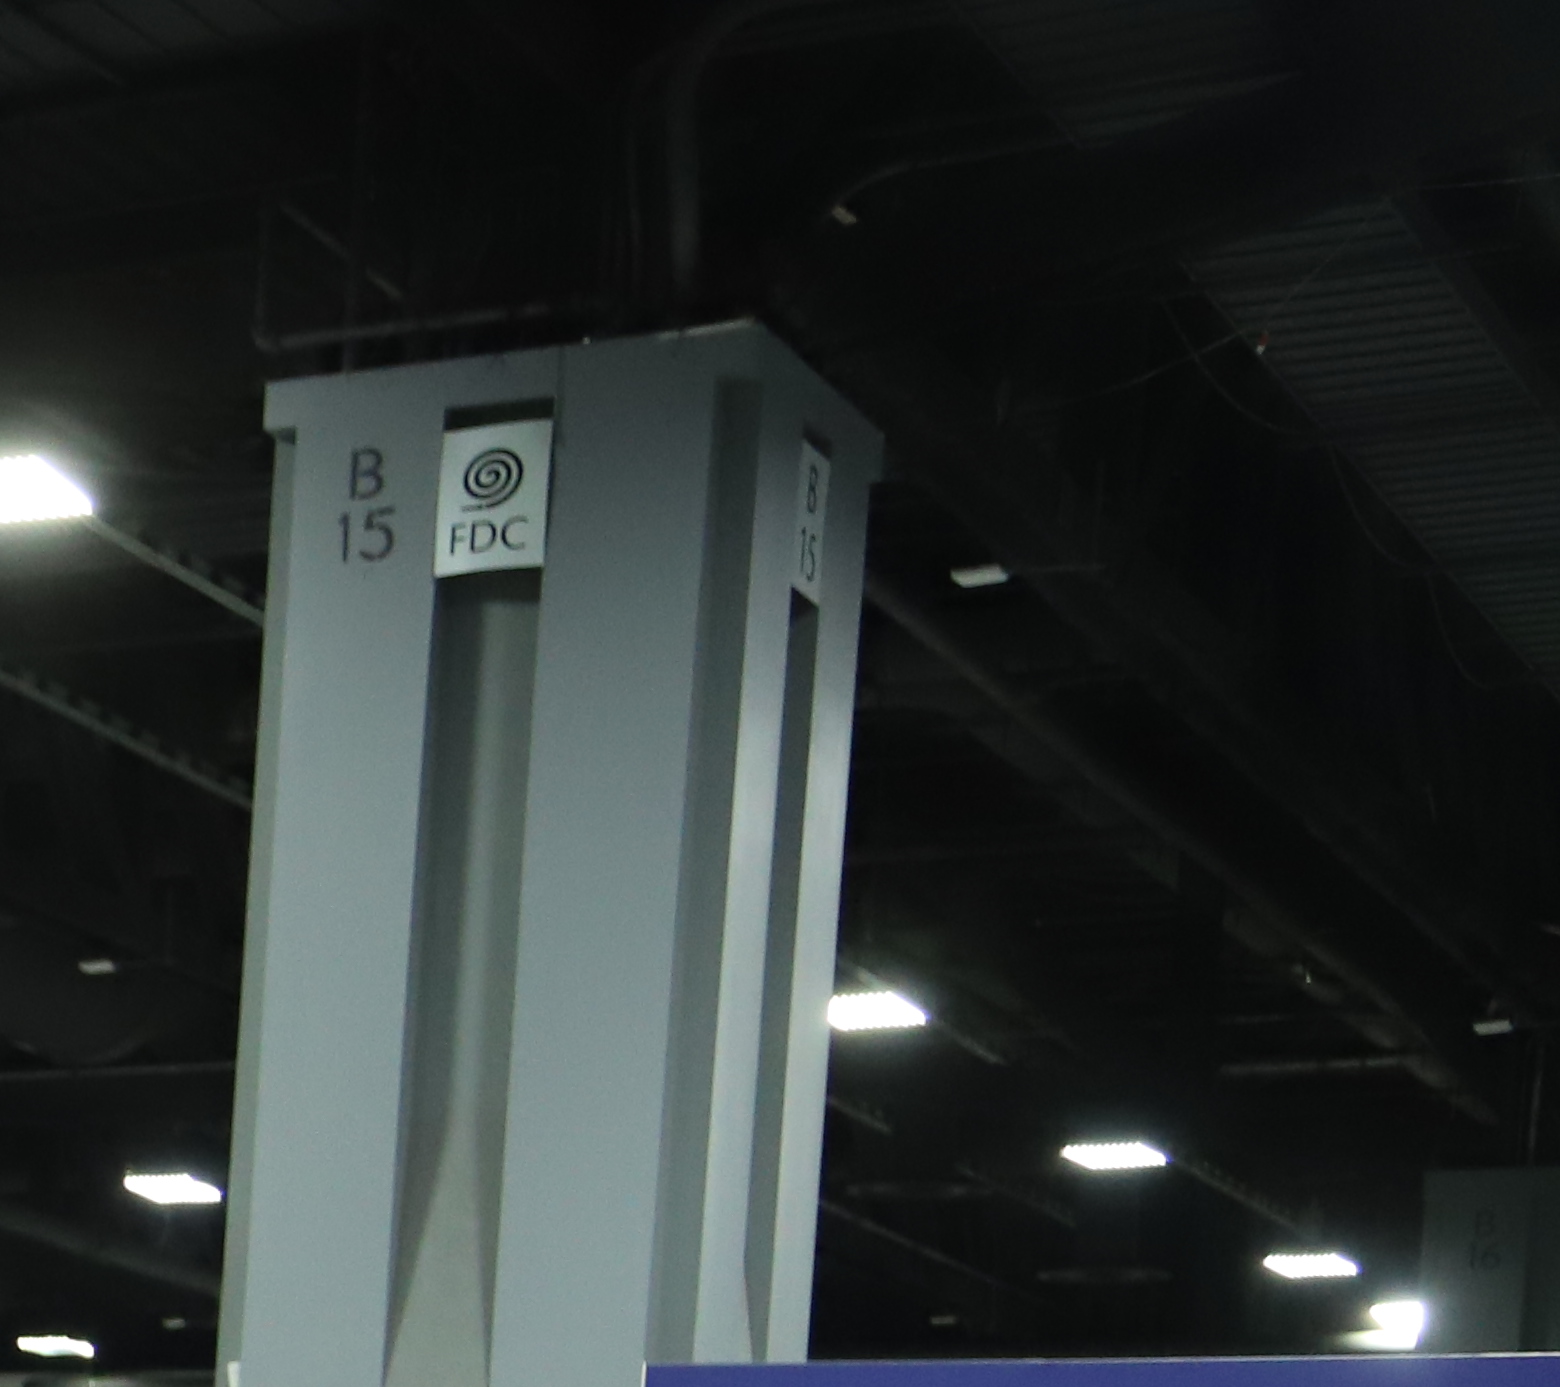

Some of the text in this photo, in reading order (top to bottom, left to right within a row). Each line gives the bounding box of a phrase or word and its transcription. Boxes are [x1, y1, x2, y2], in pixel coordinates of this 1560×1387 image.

[349, 446, 386, 501] B
[805, 463, 819, 516] B
[338, 507, 396, 563] 15
[449, 515, 528, 557] FDC
[798, 525, 817, 583] 15
